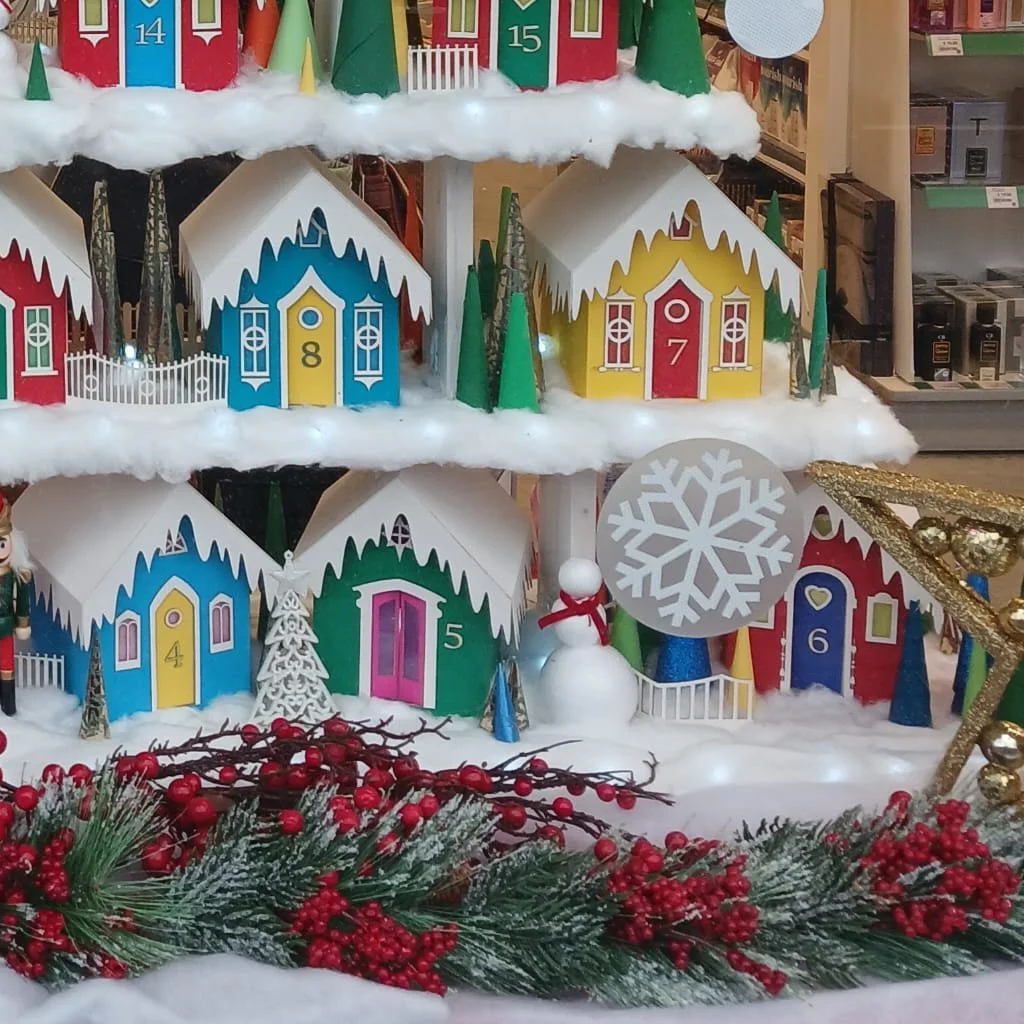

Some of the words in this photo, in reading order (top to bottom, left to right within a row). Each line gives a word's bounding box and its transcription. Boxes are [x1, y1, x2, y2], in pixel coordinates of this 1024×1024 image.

[135, 17, 165, 44] 14
[508, 26, 541, 52] 15
[302, 341, 321, 367] 8
[668, 339, 688, 365] 7
[444, 624, 463, 649] 5
[808, 628, 828, 653] 6
[164, 641, 183, 668] 4
